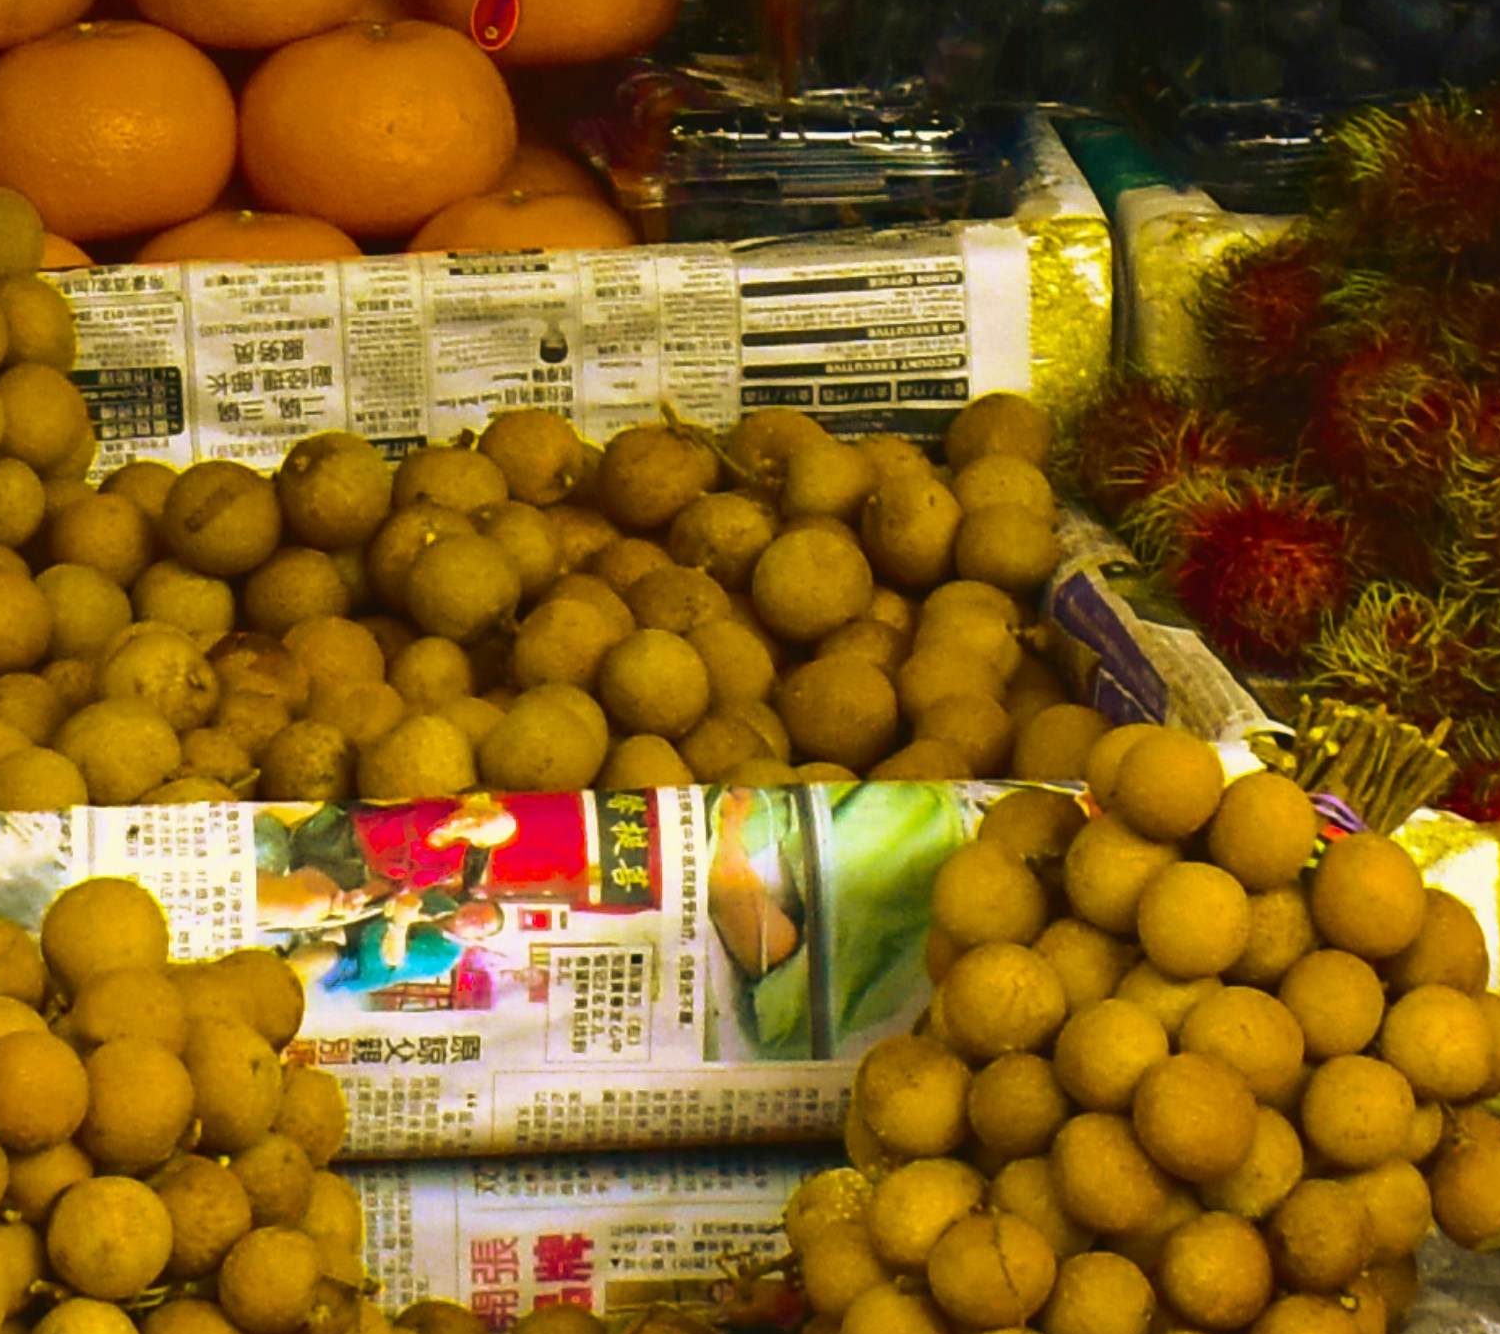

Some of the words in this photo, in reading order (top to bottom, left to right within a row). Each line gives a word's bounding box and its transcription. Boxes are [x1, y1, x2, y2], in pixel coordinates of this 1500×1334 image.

[867, 325, 938, 337] EXECUTIVE
[232, 339, 304, 365] 服务员
[825, 359, 896, 373] EXECUTIVE
[900, 356, 960, 370] ACCOUNT
